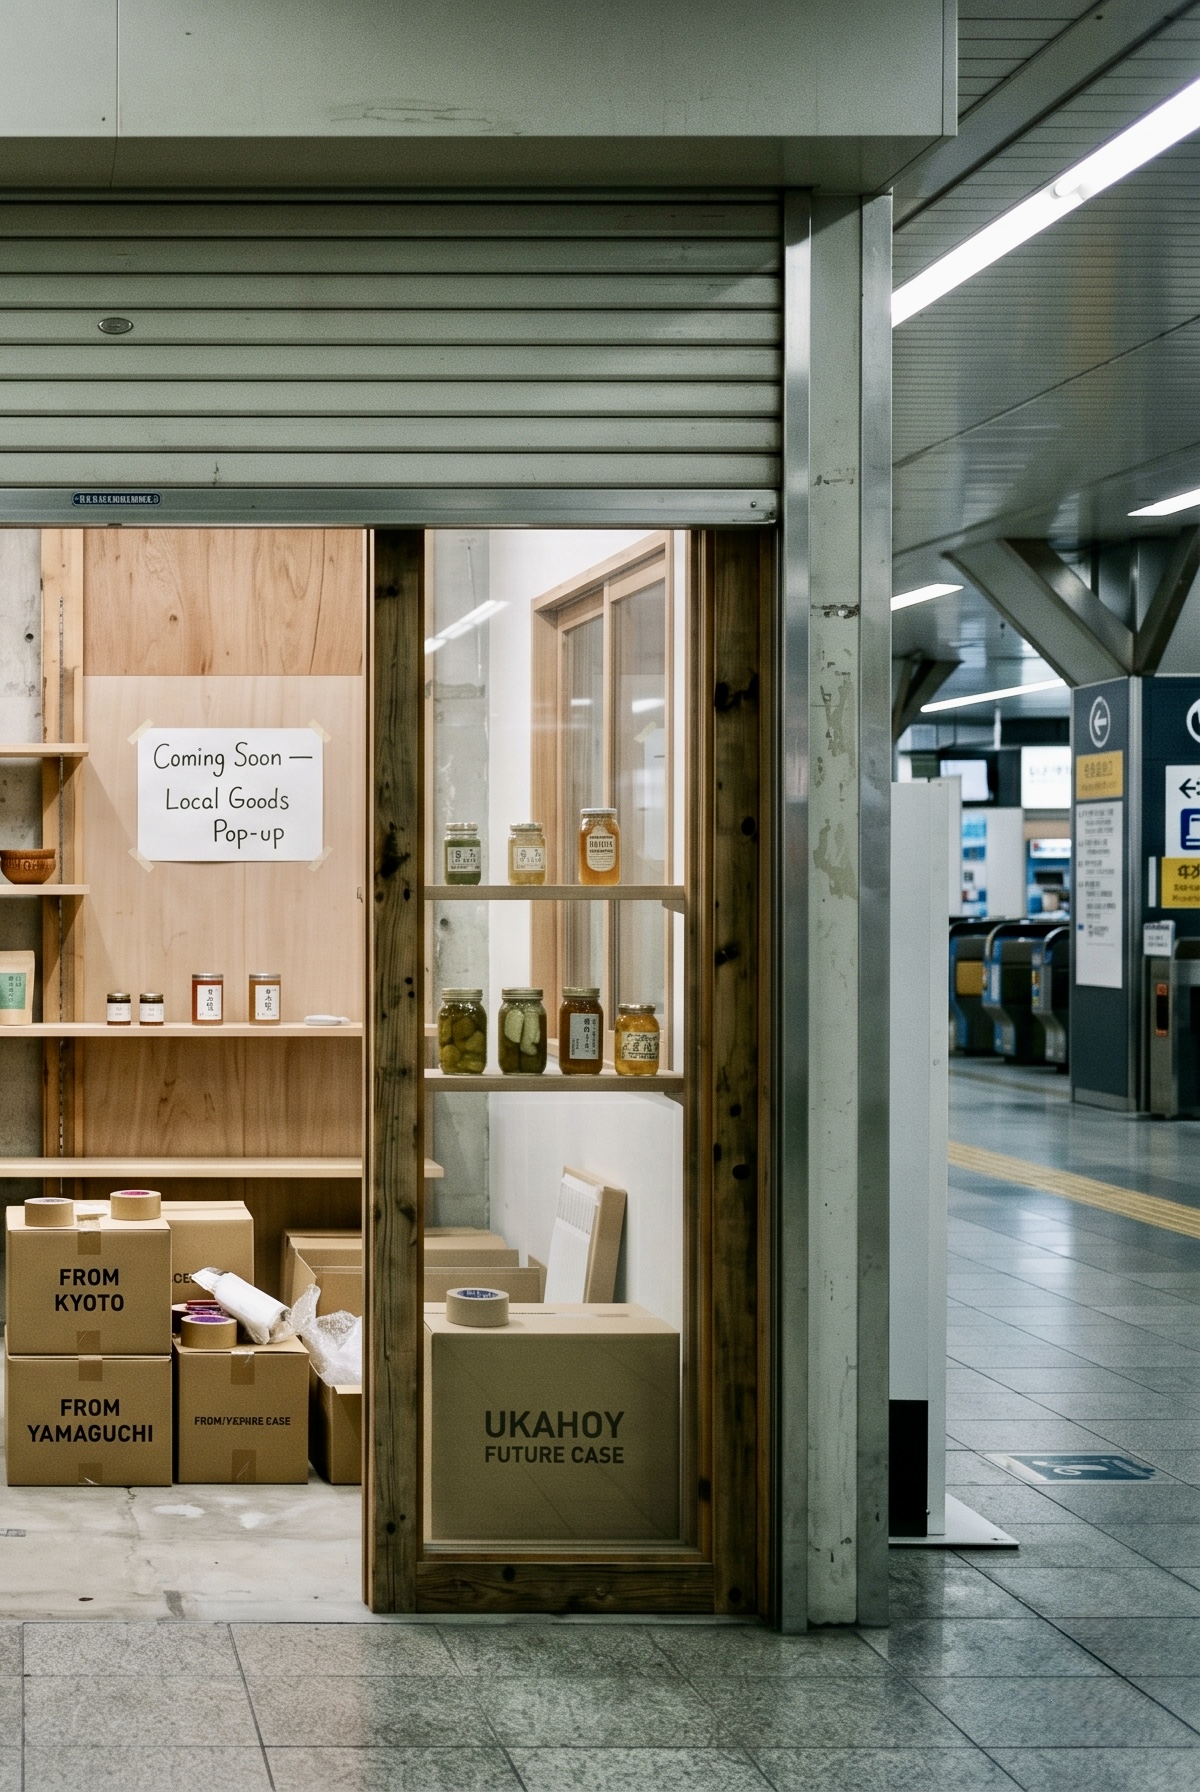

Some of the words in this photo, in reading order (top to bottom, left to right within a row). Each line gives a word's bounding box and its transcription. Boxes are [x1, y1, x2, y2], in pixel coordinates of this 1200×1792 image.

[153, 743, 225, 777] Coming
[234, 741, 282, 767] Soon
[166, 786, 218, 810] Local
[229, 786, 290, 810] Goods
[214, 818, 285, 850] Pop-up
[59, 1268, 119, 1286] FROM
[55, 1294, 125, 1312] KYOTO
[60, 1399, 120, 1417] FROM
[27, 1424, 153, 1443] YAMAGUCHI
[485, 1410, 625, 1439] UKAHOY
[485, 1446, 565, 1464] FUTURE
[571, 1446, 624, 1464] CASE
